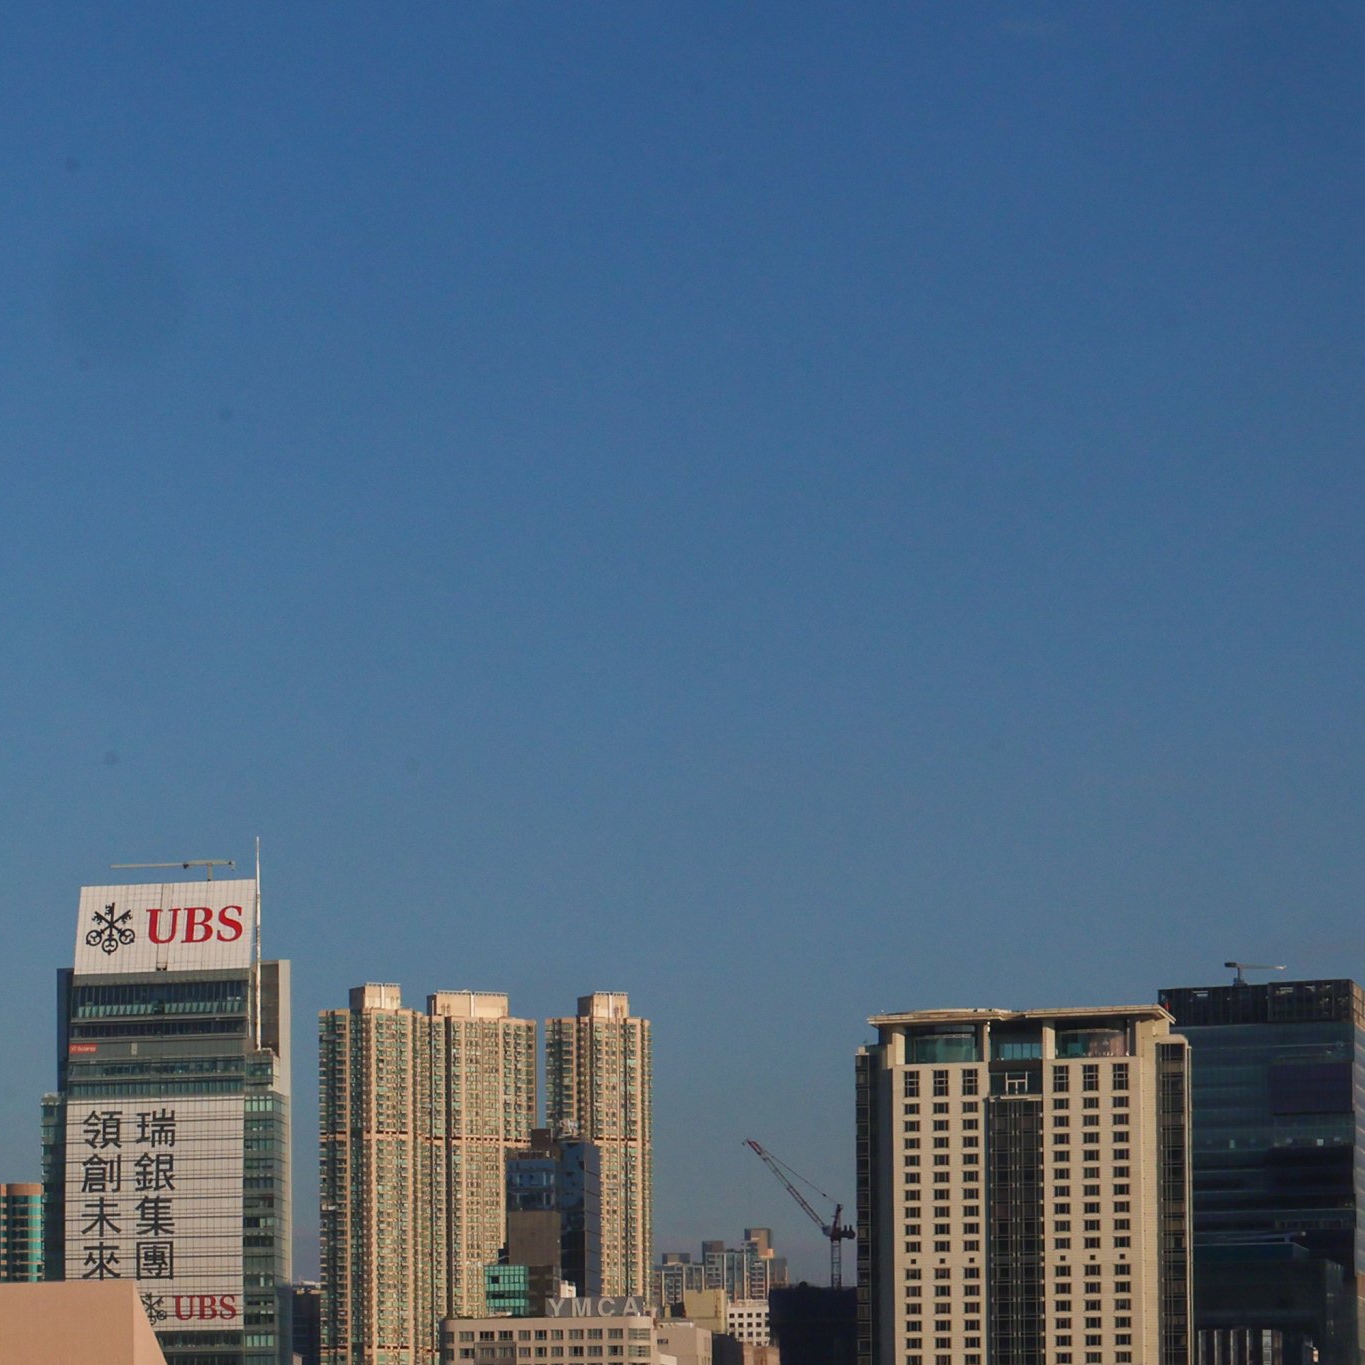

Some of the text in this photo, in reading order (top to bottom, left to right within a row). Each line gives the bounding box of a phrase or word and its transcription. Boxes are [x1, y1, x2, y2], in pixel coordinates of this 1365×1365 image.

[146, 905, 243, 944] UBS
[81, 1110, 123, 1281] 領創未來
[134, 1108, 176, 1281] 瑞銀集團
[174, 1295, 237, 1321] UBS
[548, 1297, 639, 1317] YMCA
